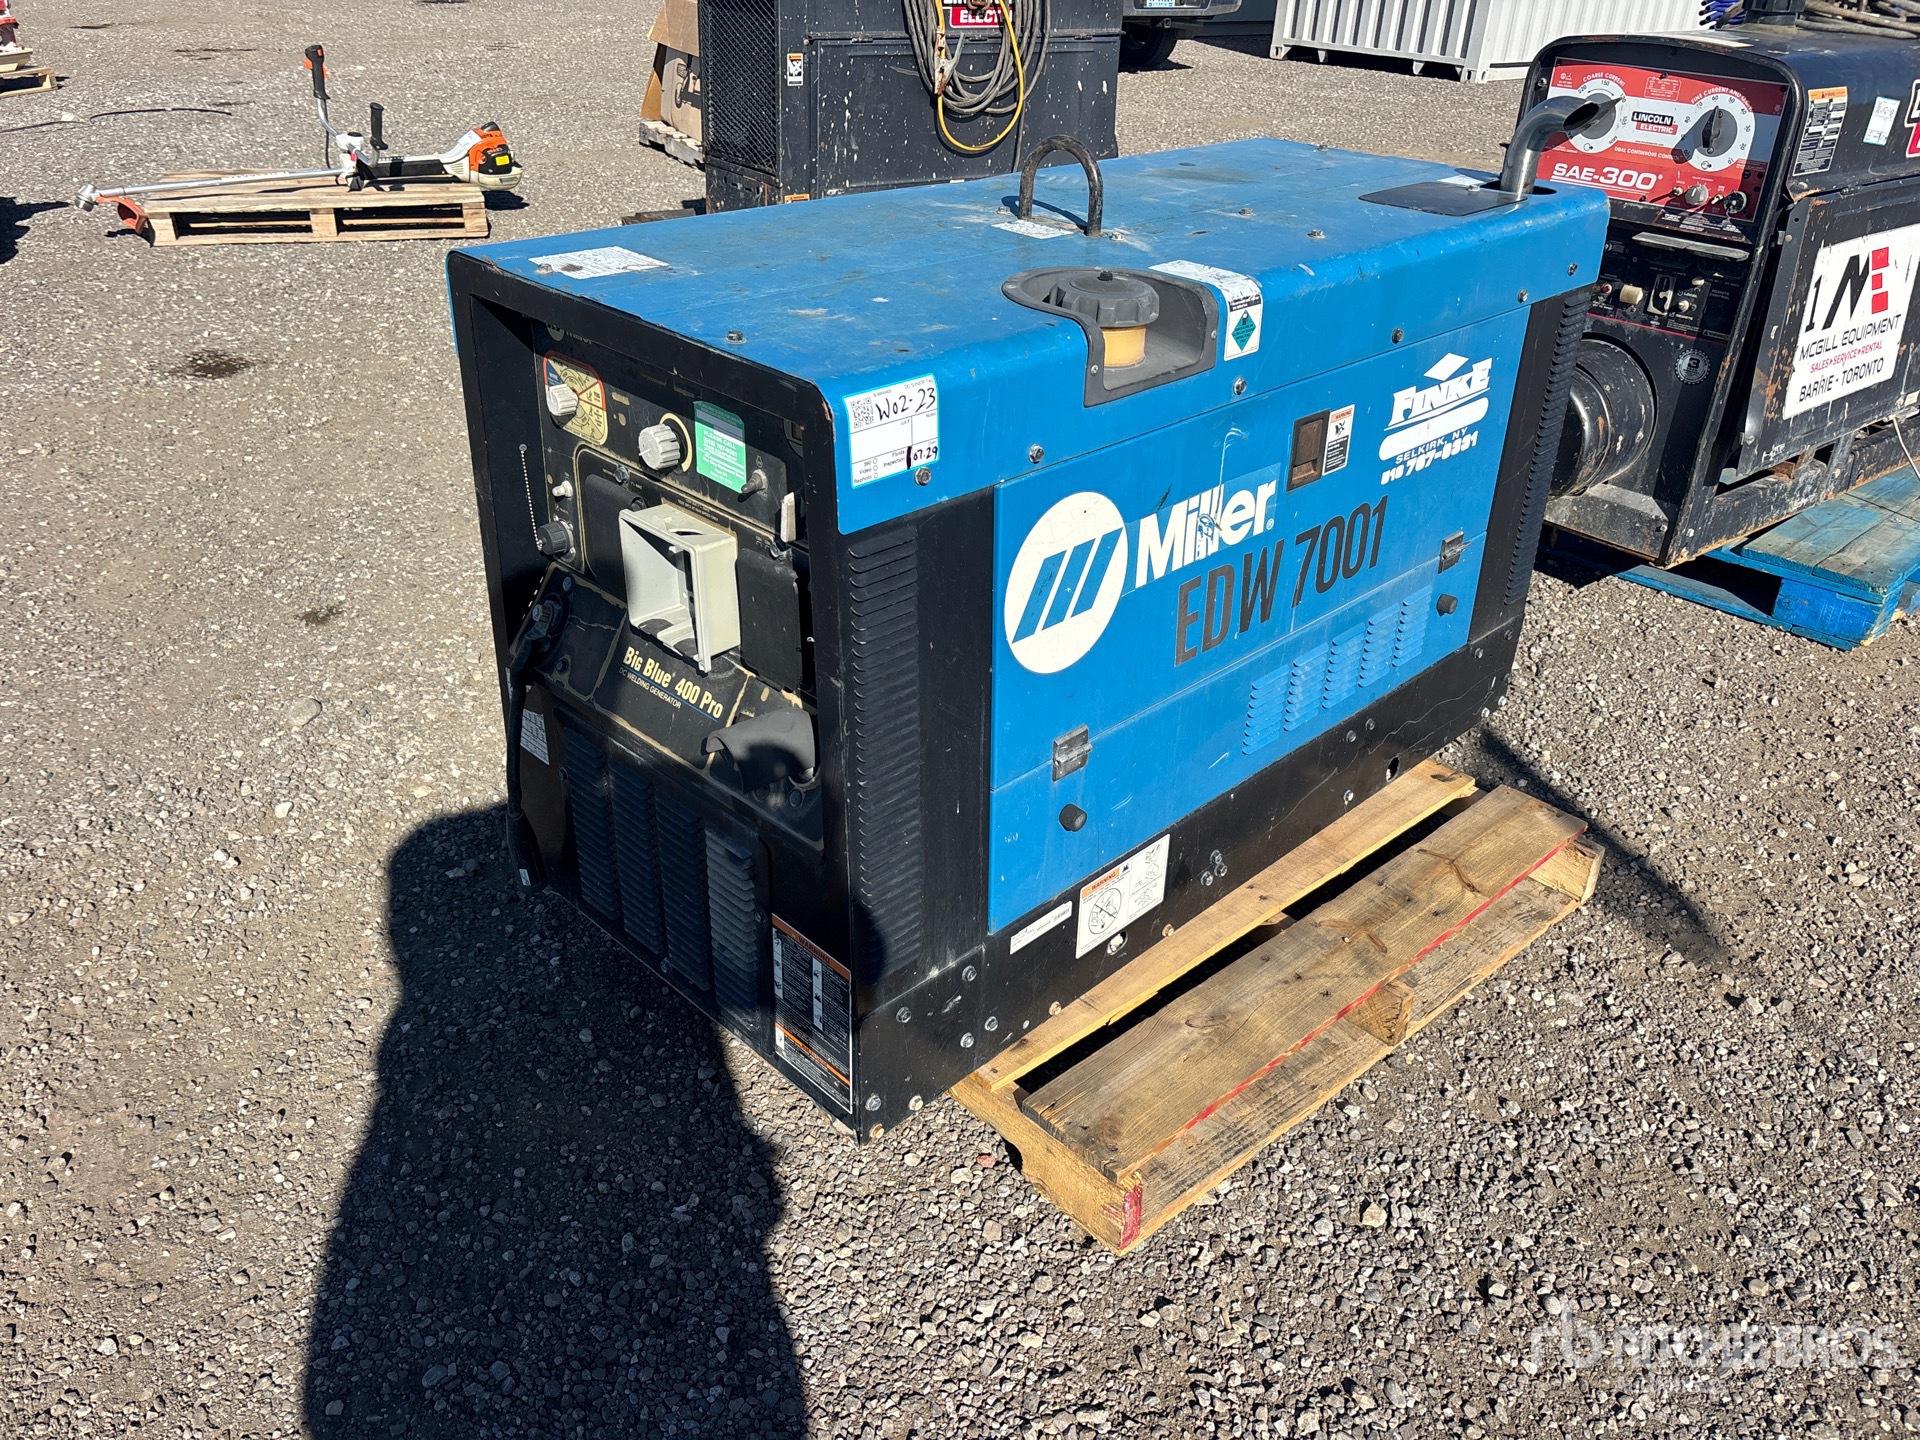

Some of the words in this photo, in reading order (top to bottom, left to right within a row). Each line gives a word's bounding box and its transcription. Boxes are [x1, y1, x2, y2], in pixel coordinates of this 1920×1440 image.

[1582, 71, 1604, 82] COARSE
[1604, 72, 1626, 87] CURRENT
[1691, 92, 1702, 104] FINE
[1703, 87, 1729, 96] CURRENT
[1633, 112, 1672, 125] LINCOLN
[1640, 123, 1674, 134] ELECTRIC
[1627, 147, 1657, 158] CONTINUOUS
[1552, 163, 1658, 190] SAE-300
[1799, 337, 1838, 361] MCGILL
[1841, 314, 1901, 347] EQUIPMENT
[1687, 357, 1700, 369] 3
[1810, 359, 1831, 374] SALES
[1832, 348, 1857, 366] SERVICE
[1860, 340, 1883, 355] RENTAL
[1388, 358, 1492, 427] FINKE
[1799, 374, 1835, 402] BARRIE
[1841, 357, 1884, 386] TORONTO
[1395, 437, 1448, 464] SELKIRK,
[1452, 427, 1467, 441] NY
[1136, 480, 1276, 589] Miller
[1291, 495, 1388, 609] 7001
[627, 671, 650, 690] WELDING
[649, 685, 682, 709] GENERATOR
[643, 658, 672, 688] Blue
[674, 678, 700, 704] 400
[699, 691, 723, 719] Pro
[1091, 872, 1117, 891] WARNING
[798, 936, 831, 964] WARNING
